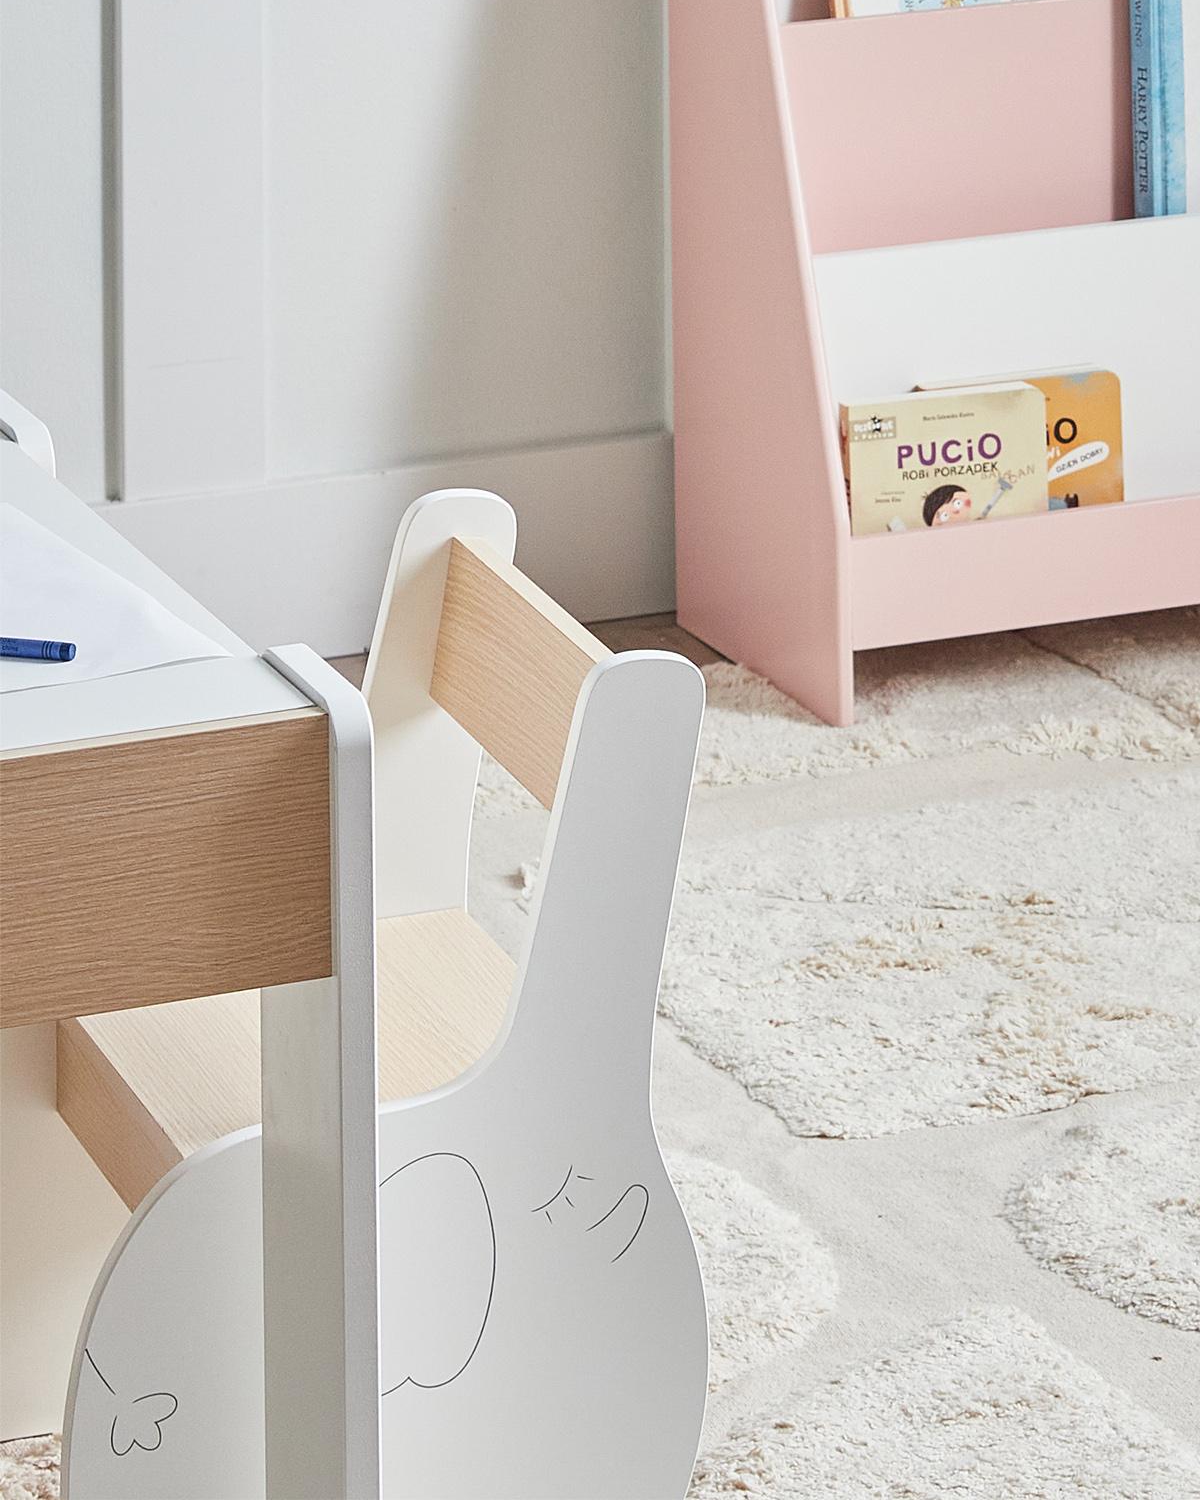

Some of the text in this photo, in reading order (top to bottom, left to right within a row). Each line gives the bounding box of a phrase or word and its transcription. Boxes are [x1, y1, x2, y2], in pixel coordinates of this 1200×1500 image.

[1137, 66, 1149, 193] HARRY POTTER
[934, 461, 999, 478] PORZĄDEK
